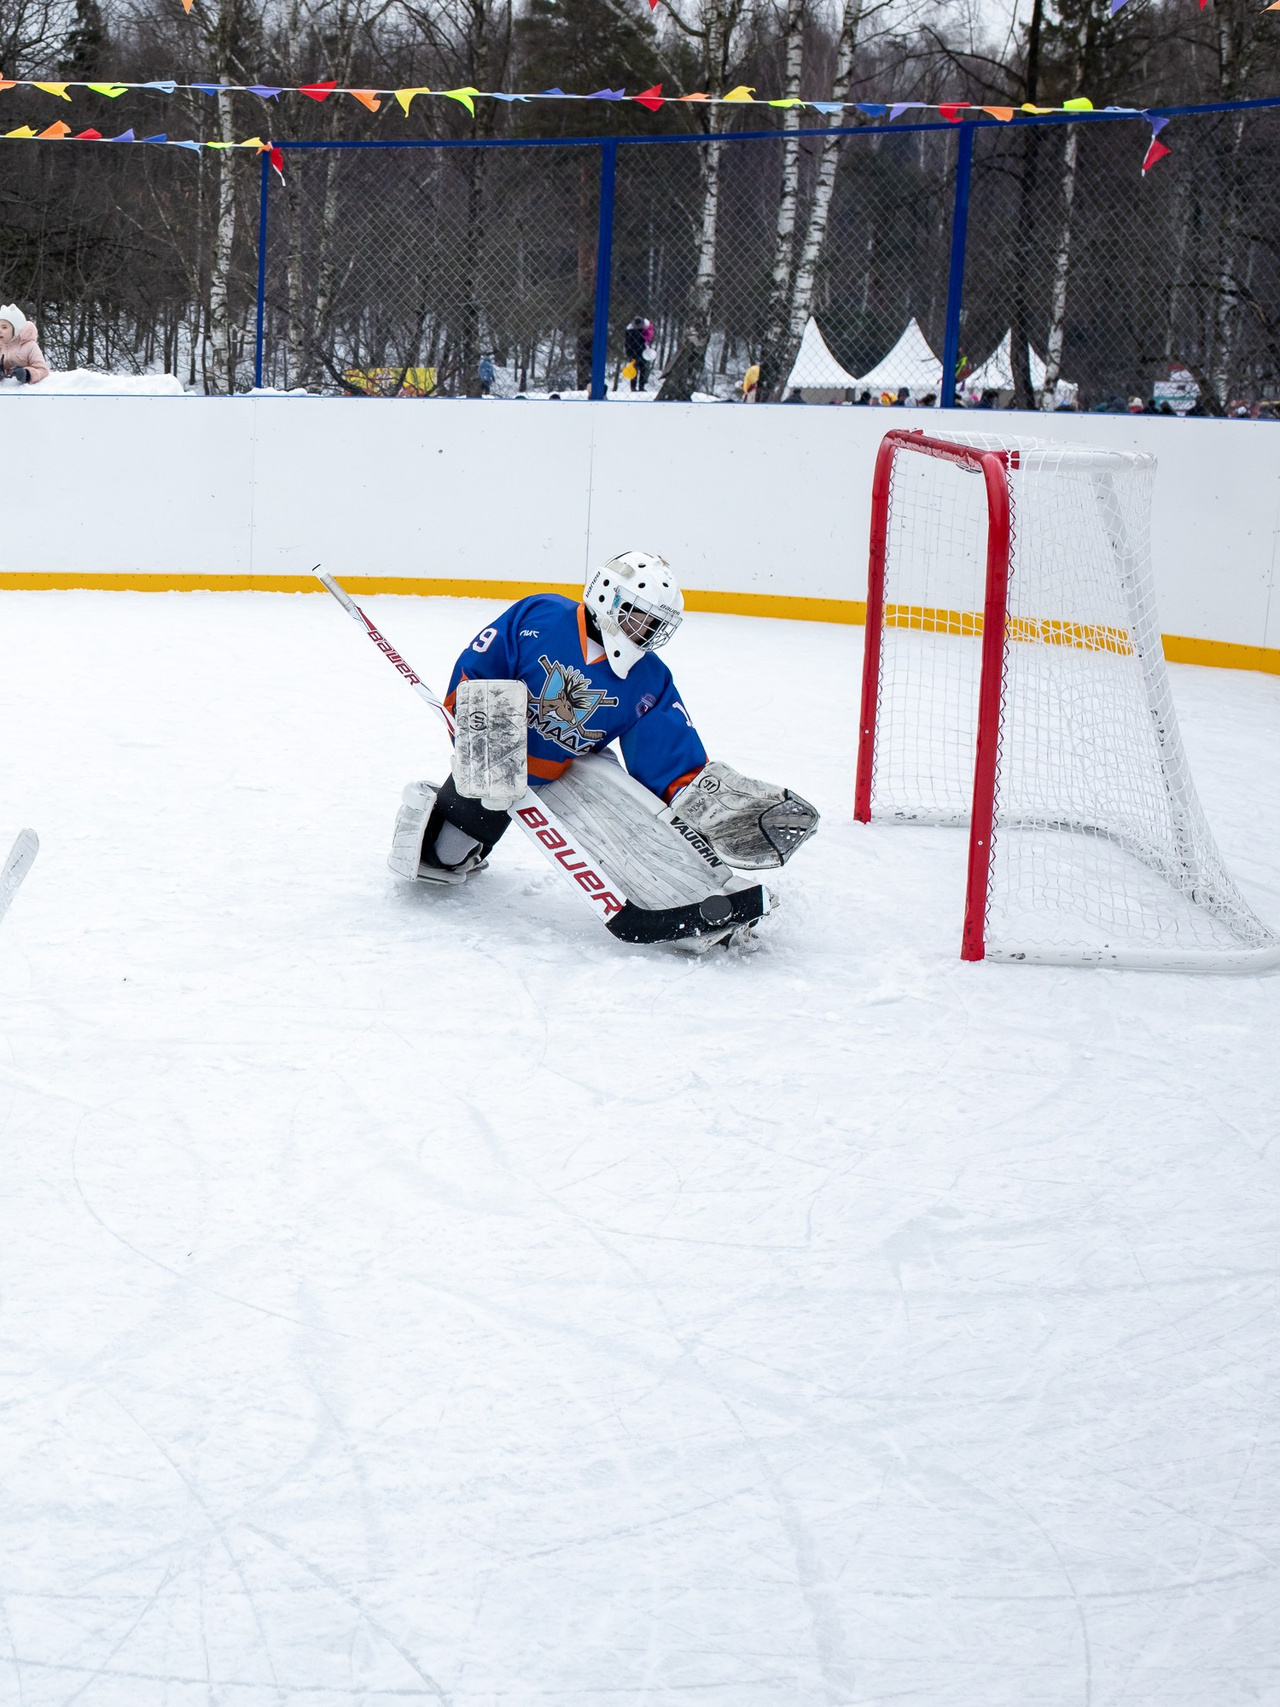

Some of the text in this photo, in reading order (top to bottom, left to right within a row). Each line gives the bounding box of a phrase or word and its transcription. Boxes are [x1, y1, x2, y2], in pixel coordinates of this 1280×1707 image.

[367, 630, 421, 686] BAUER
[466, 627, 498, 653] 9
[516, 806, 623, 915] BAUER
[670, 816, 723, 868] VAUGHN
